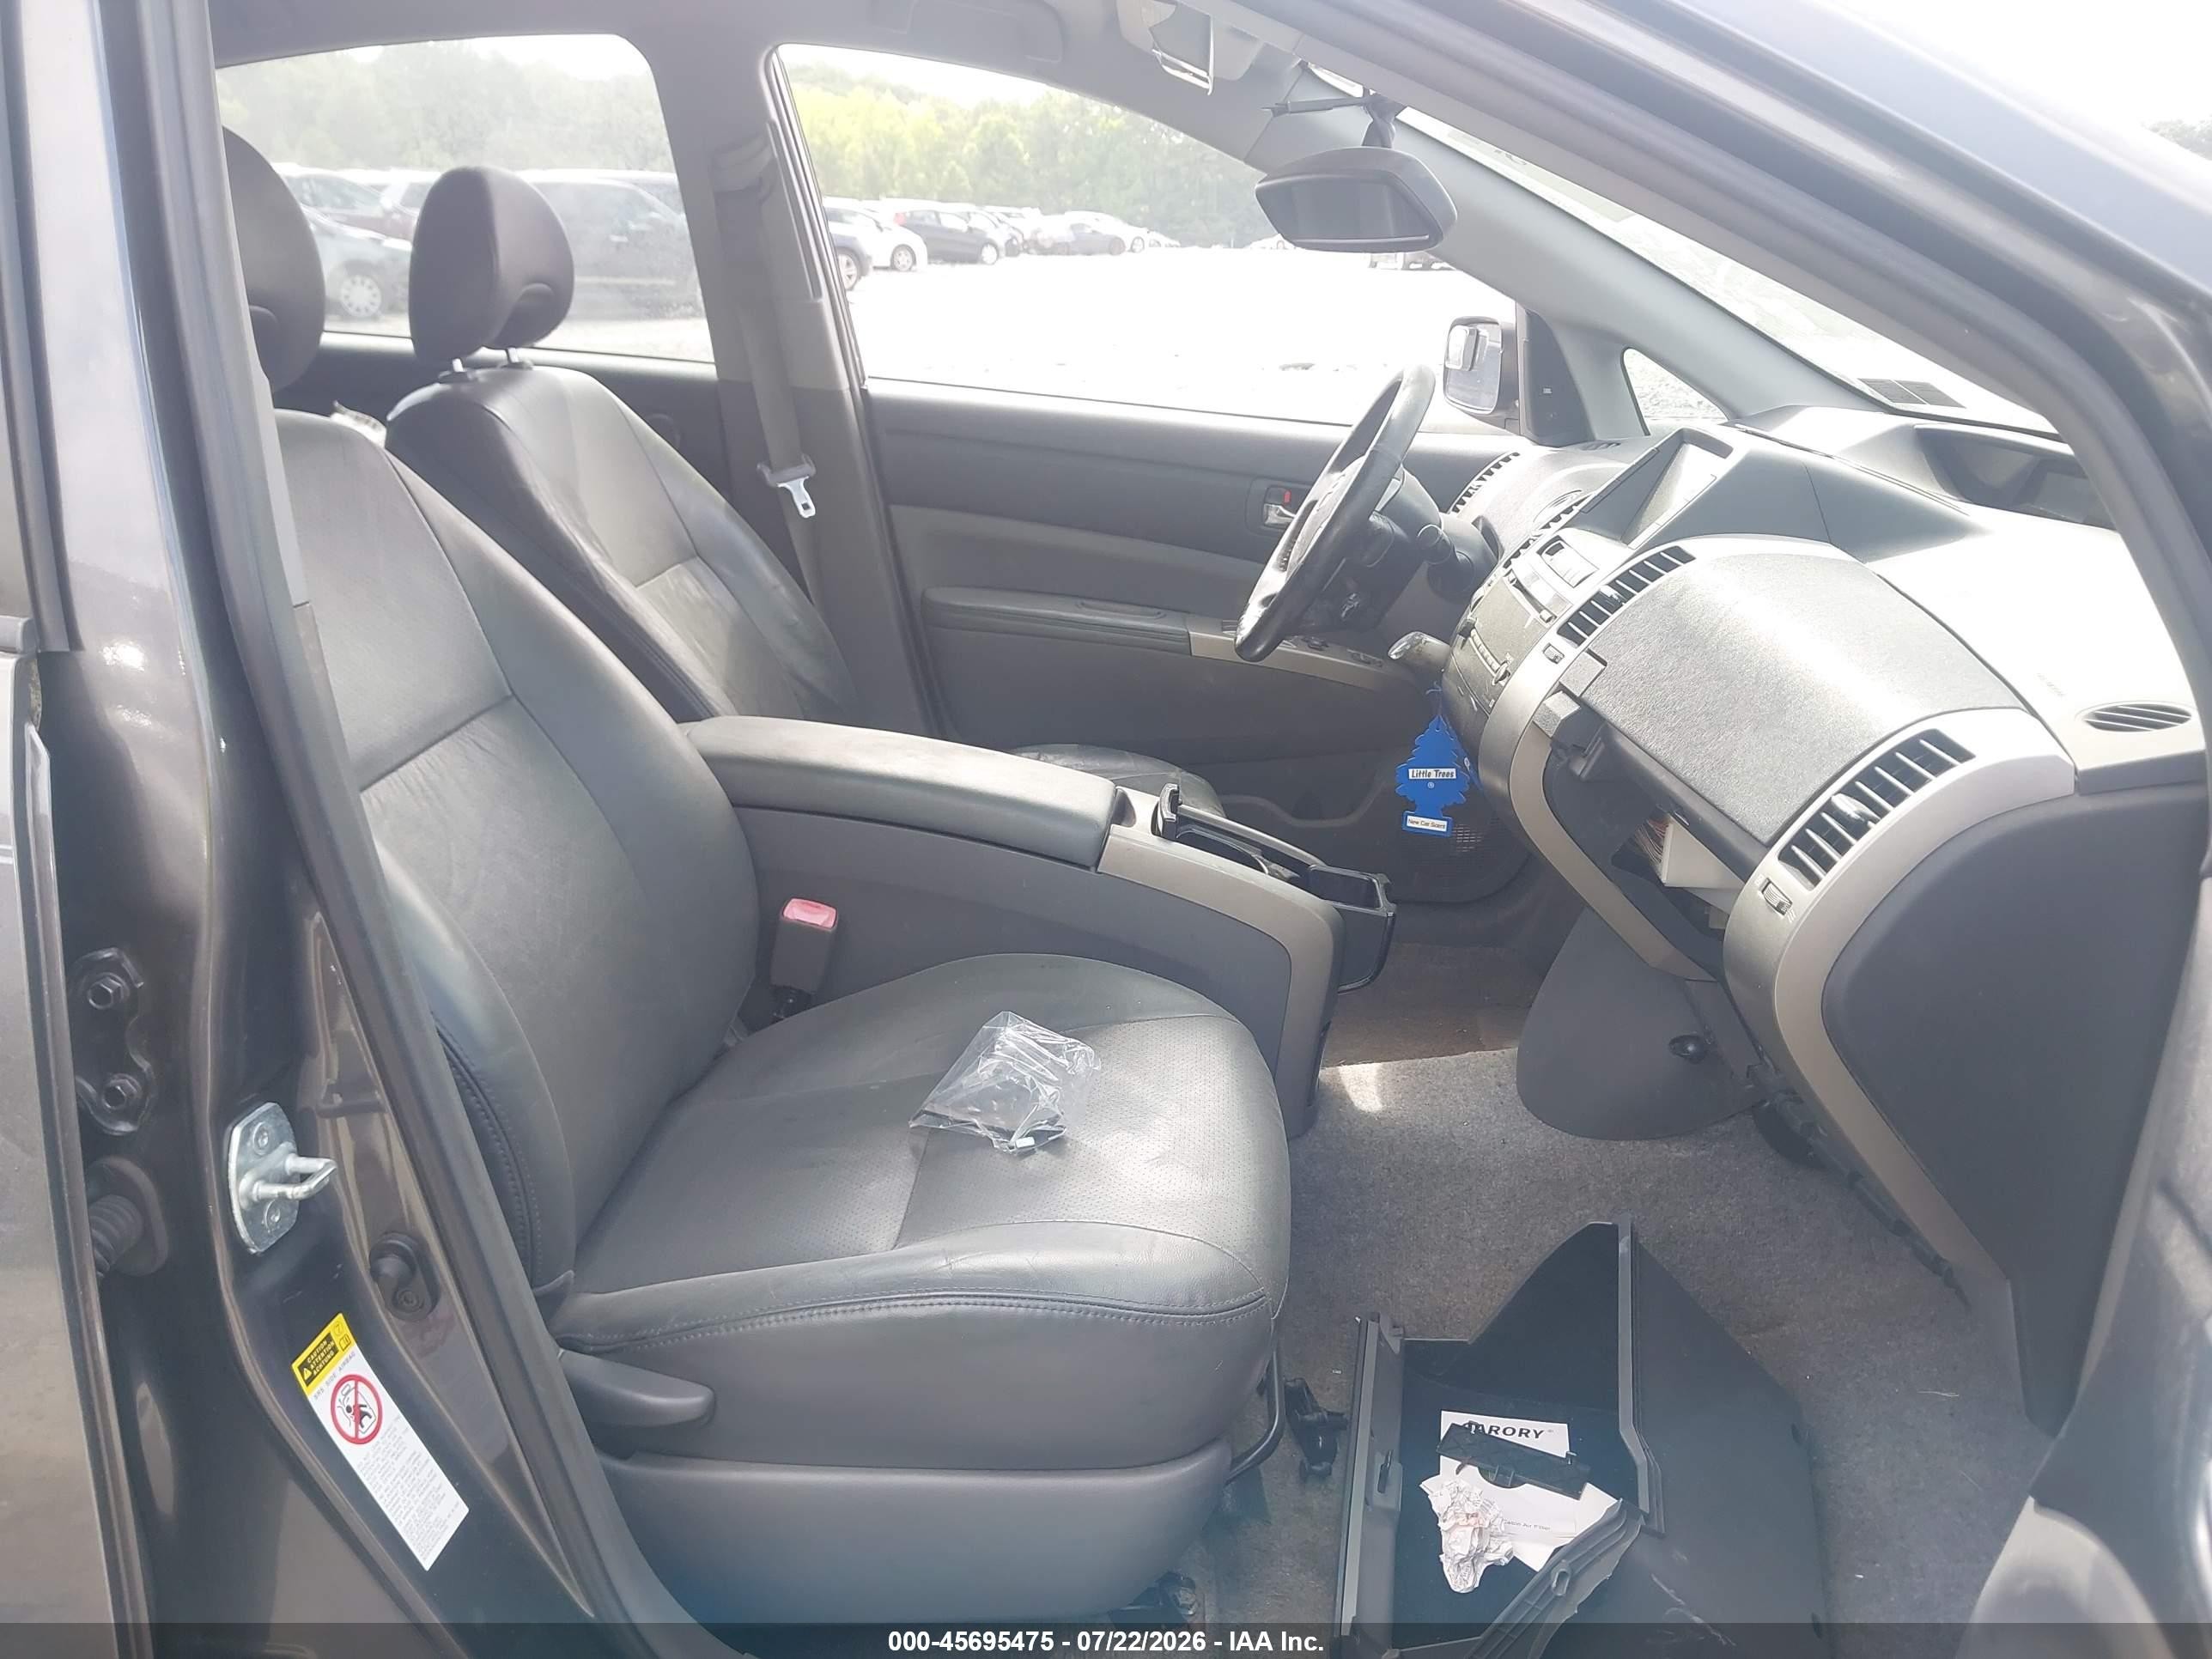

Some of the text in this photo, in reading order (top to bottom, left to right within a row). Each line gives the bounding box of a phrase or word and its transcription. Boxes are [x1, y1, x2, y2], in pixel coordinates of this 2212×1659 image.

[1412, 769, 1454, 778] Little Trees
[307, 1340, 328, 1364] CAUTION
[309, 1340, 335, 1370] ATTENTION
[313, 1350, 335, 1376] ACHTUNG
[1463, 1422, 1544, 1439] ARORY
